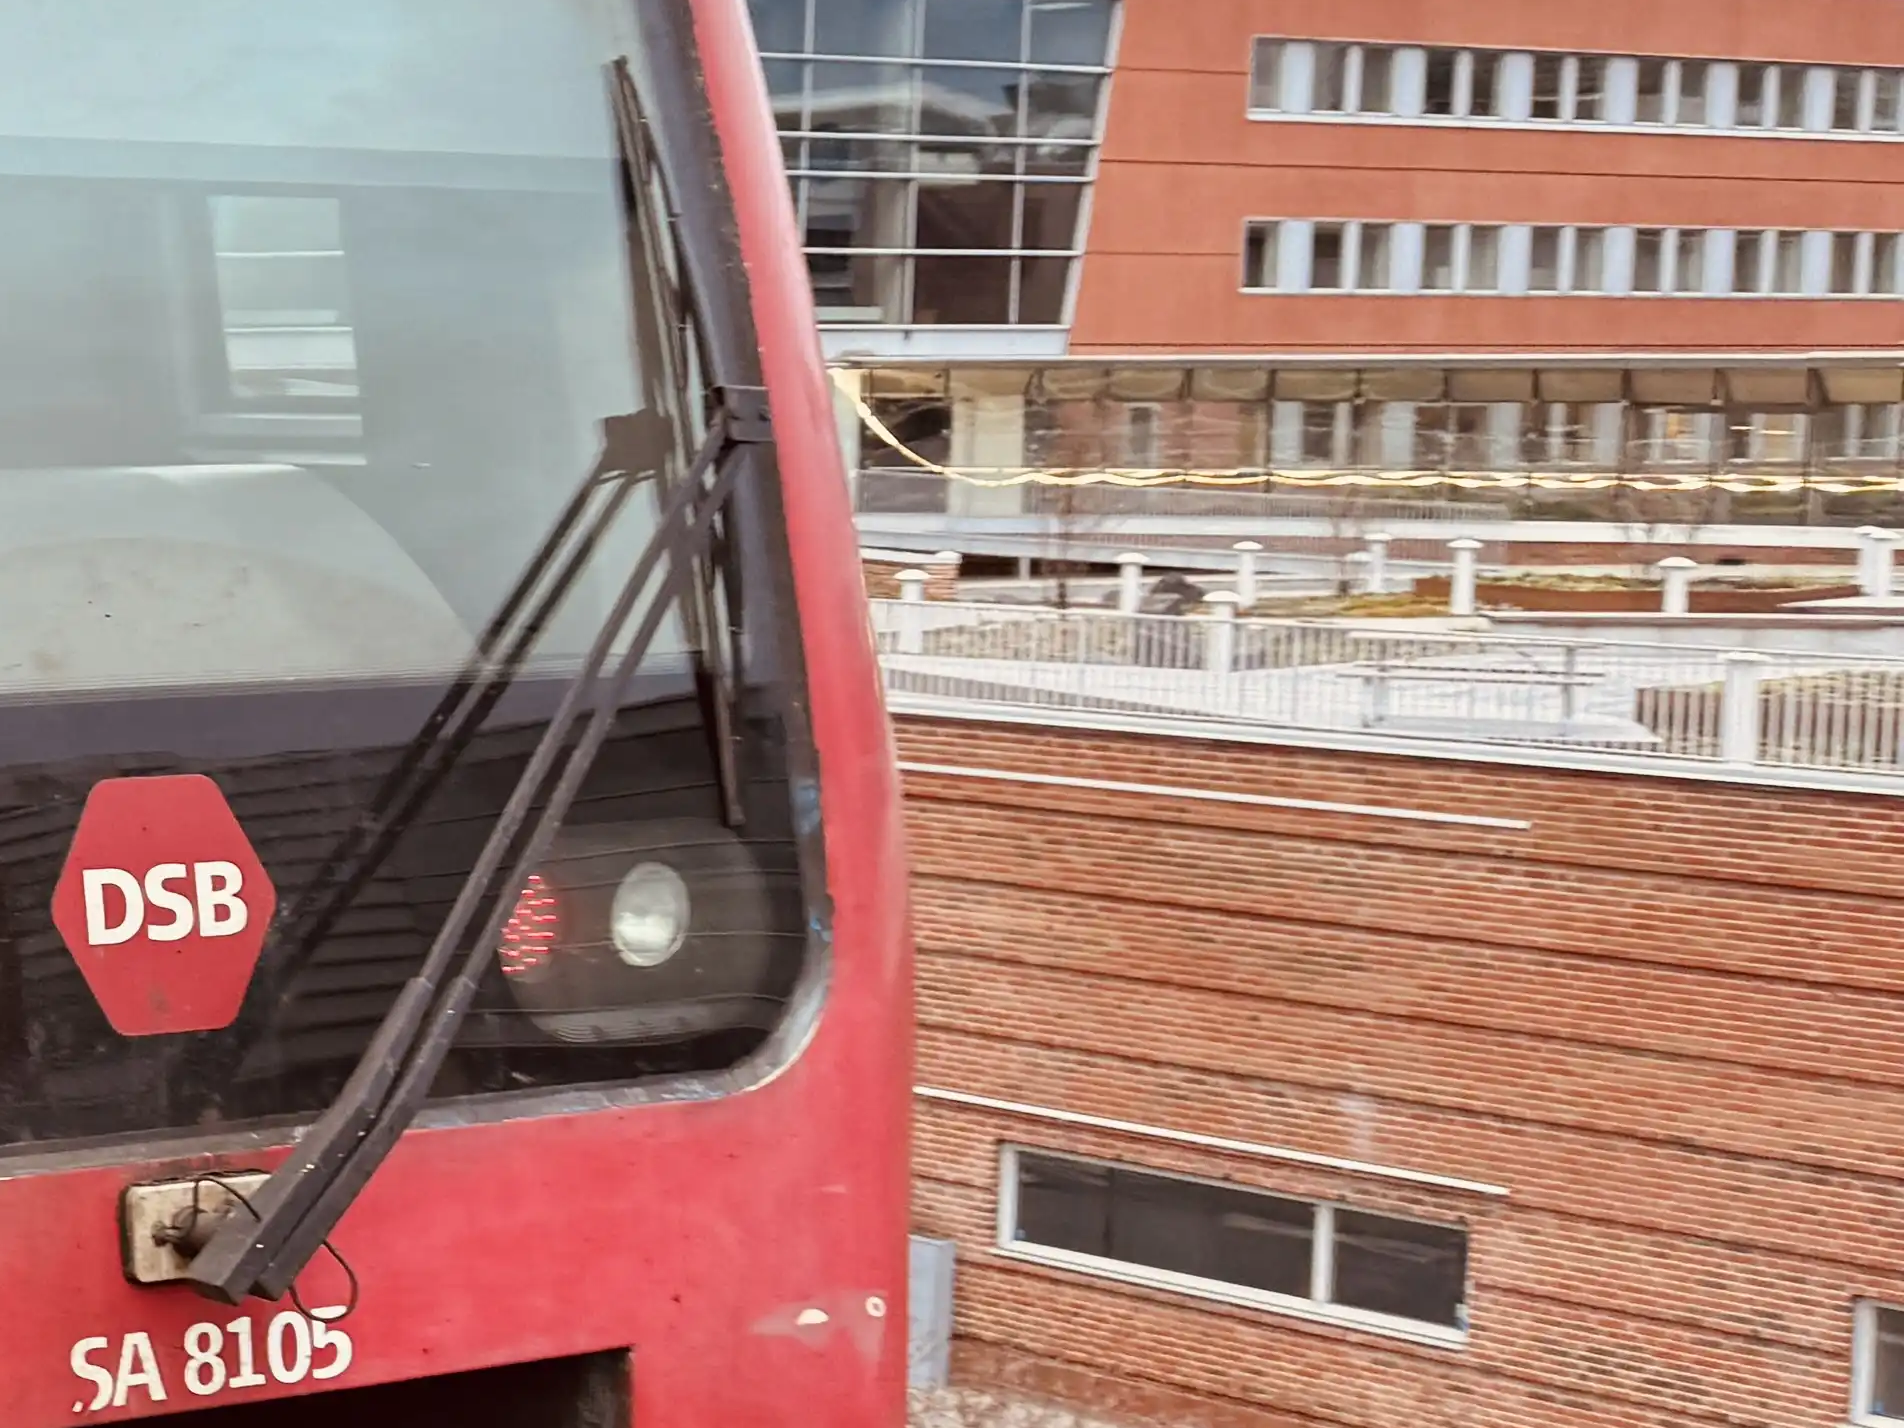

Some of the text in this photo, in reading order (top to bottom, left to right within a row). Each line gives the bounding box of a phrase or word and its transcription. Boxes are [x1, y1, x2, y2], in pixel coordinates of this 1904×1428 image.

[81, 859, 250, 946] DSB
[69, 1304, 354, 1414] SA 8105
